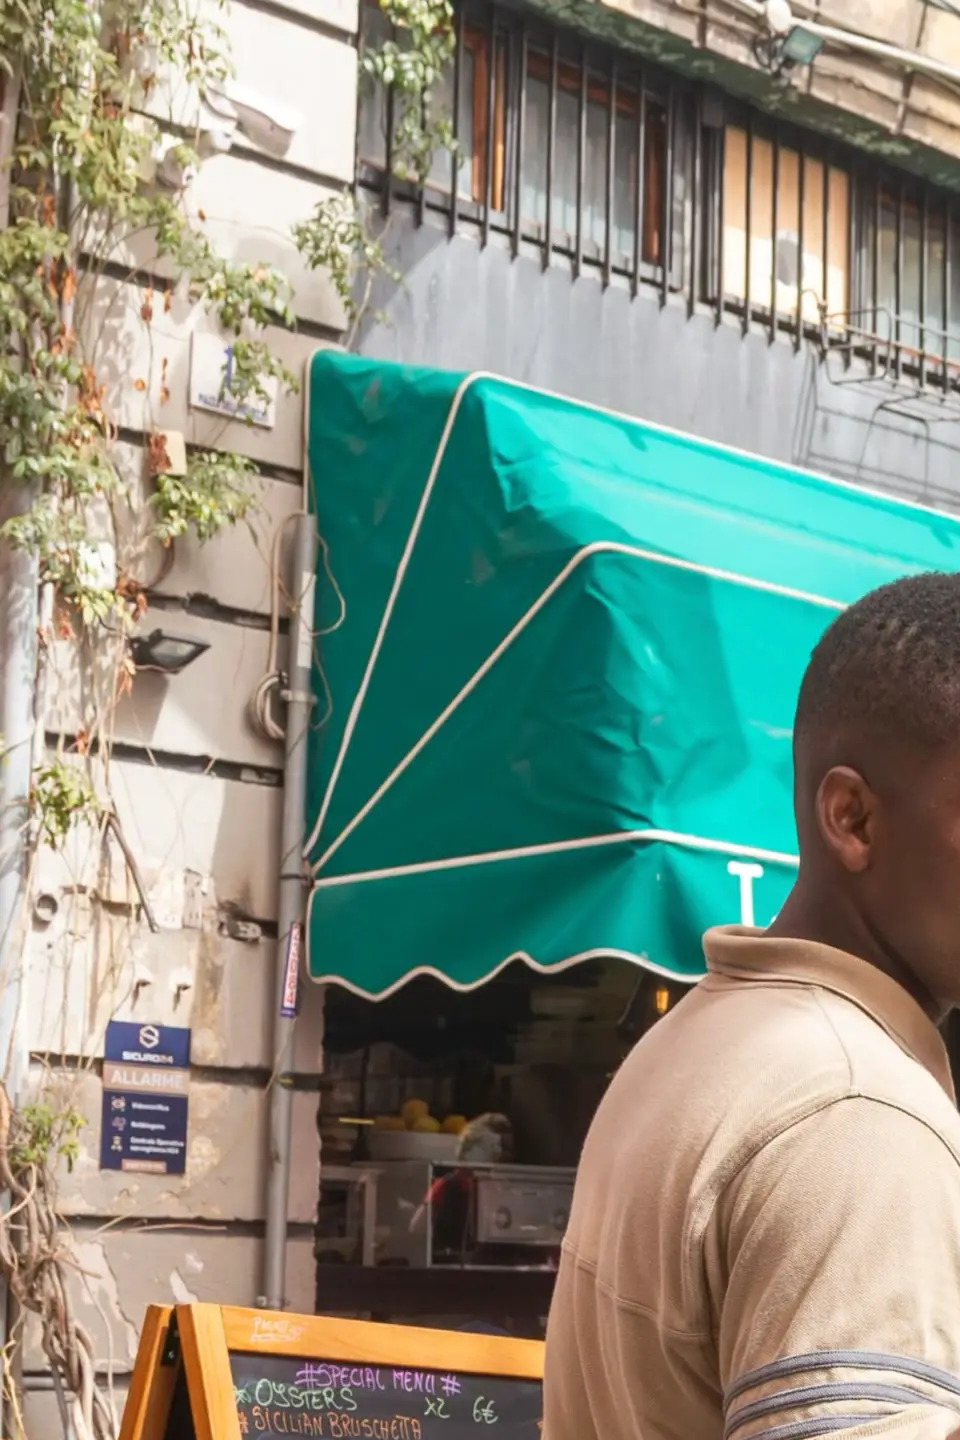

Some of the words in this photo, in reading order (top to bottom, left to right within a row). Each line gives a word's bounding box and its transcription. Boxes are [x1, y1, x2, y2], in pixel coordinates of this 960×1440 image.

[111, 1069, 184, 1090] ALLARME
[255, 1378, 357, 1411] OYSTERS
[472, 1396, 498, 1424] 6€
[252, 1405, 323, 1436] SICILIAN
[327, 1411, 422, 1440] BRUSCHETTA
